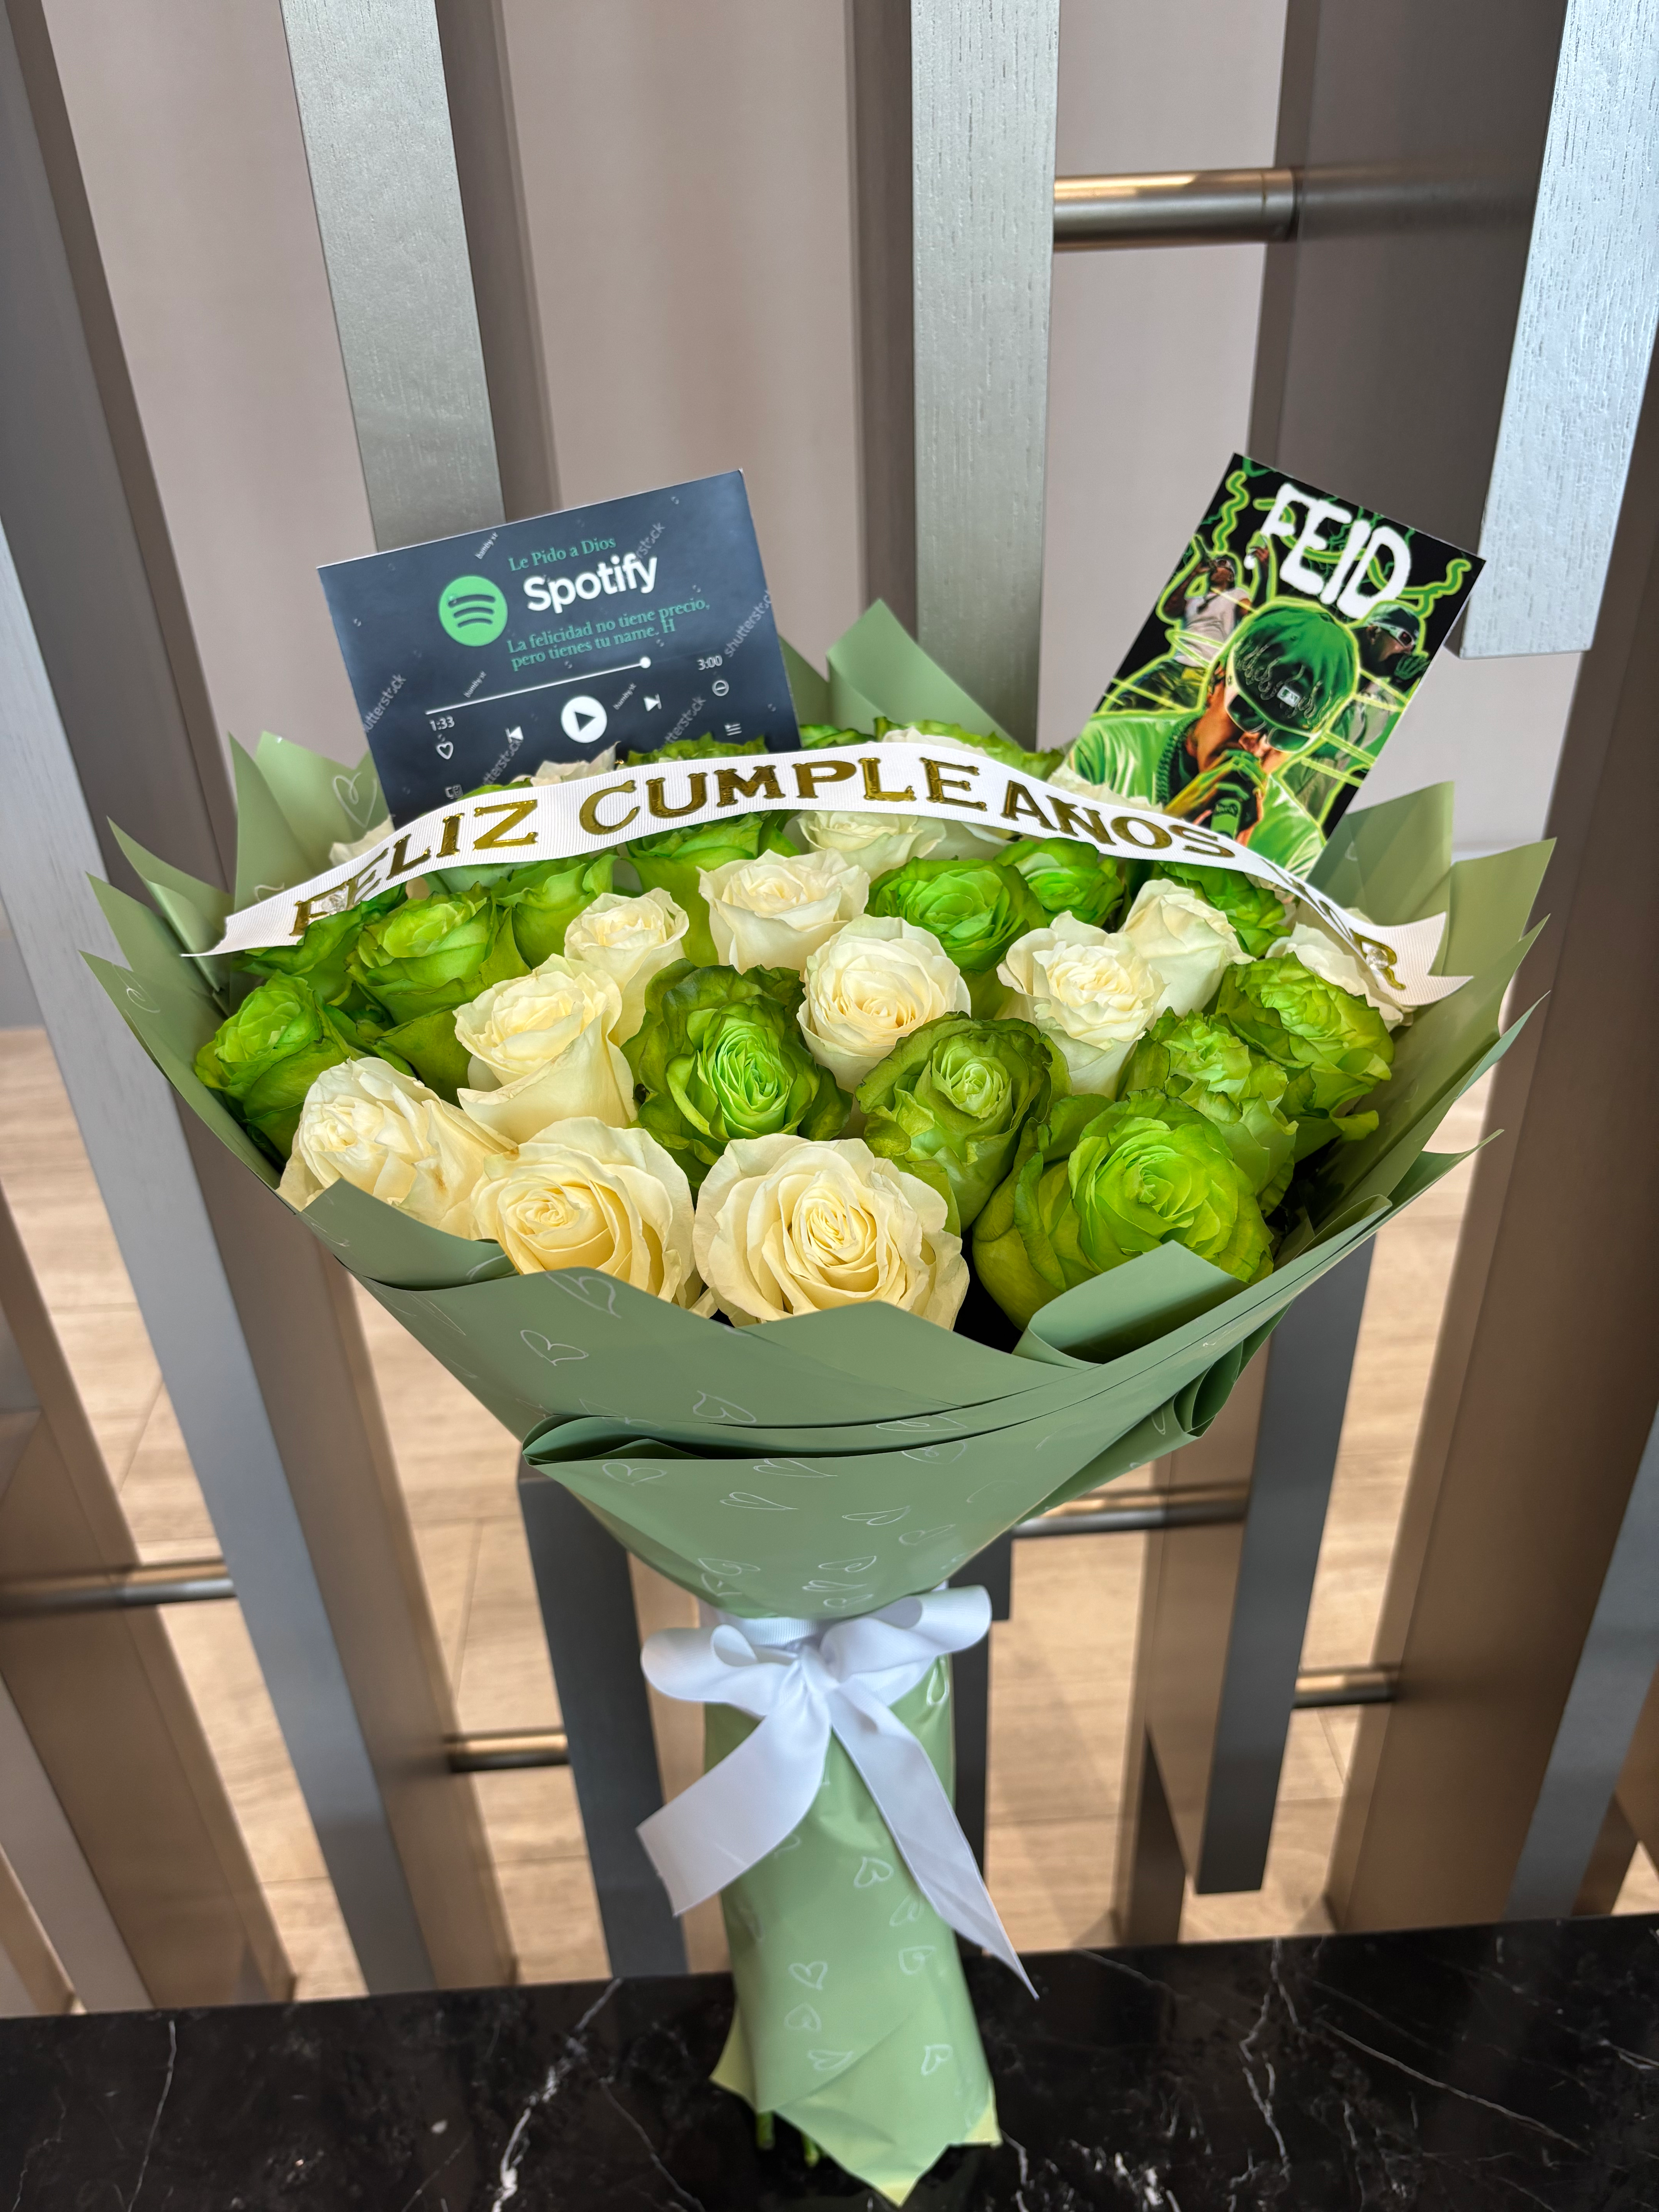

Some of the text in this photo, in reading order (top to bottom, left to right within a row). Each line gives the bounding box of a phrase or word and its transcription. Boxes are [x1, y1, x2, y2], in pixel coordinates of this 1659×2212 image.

[508, 537, 617, 572] Le Pido a Dios
[1245, 483, 1411, 620] FEID
[523, 551, 658, 614] Spotify
[507, 639, 527, 654] La
[529, 621, 592, 649] felicidad
[596, 619, 616, 634] no
[618, 609, 656, 627] tiene
[510, 651, 546, 672] pero
[548, 638, 592, 659] tienes
[595, 635, 611, 649] tu
[661, 619, 676, 634] H
[697, 655, 723, 670] 3:00
[429, 715, 455, 732] 1:33
[289, 799, 540, 937] FELIZ
